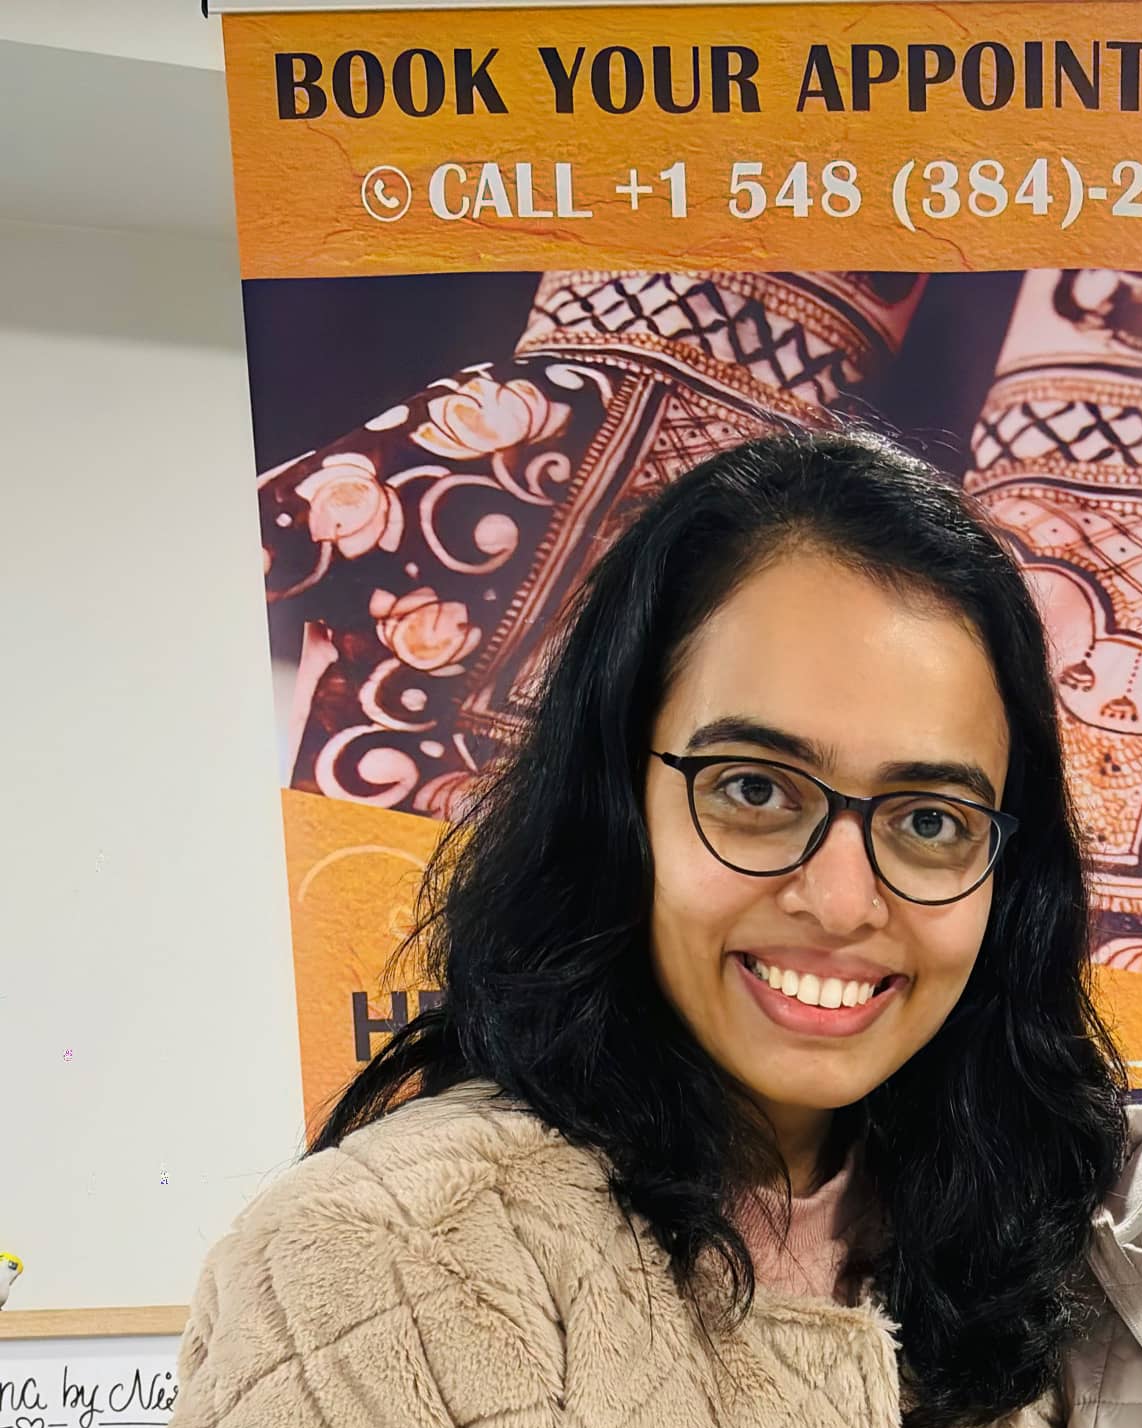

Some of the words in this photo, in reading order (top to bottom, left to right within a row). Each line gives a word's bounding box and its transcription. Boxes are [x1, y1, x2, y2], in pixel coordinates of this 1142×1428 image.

[274, 48, 510, 120] BOOK
[539, 45, 762, 115] YOUR
[428, 162, 593, 220] CALL
[615, 161, 688, 219] +1
[728, 160, 863, 220] 548
